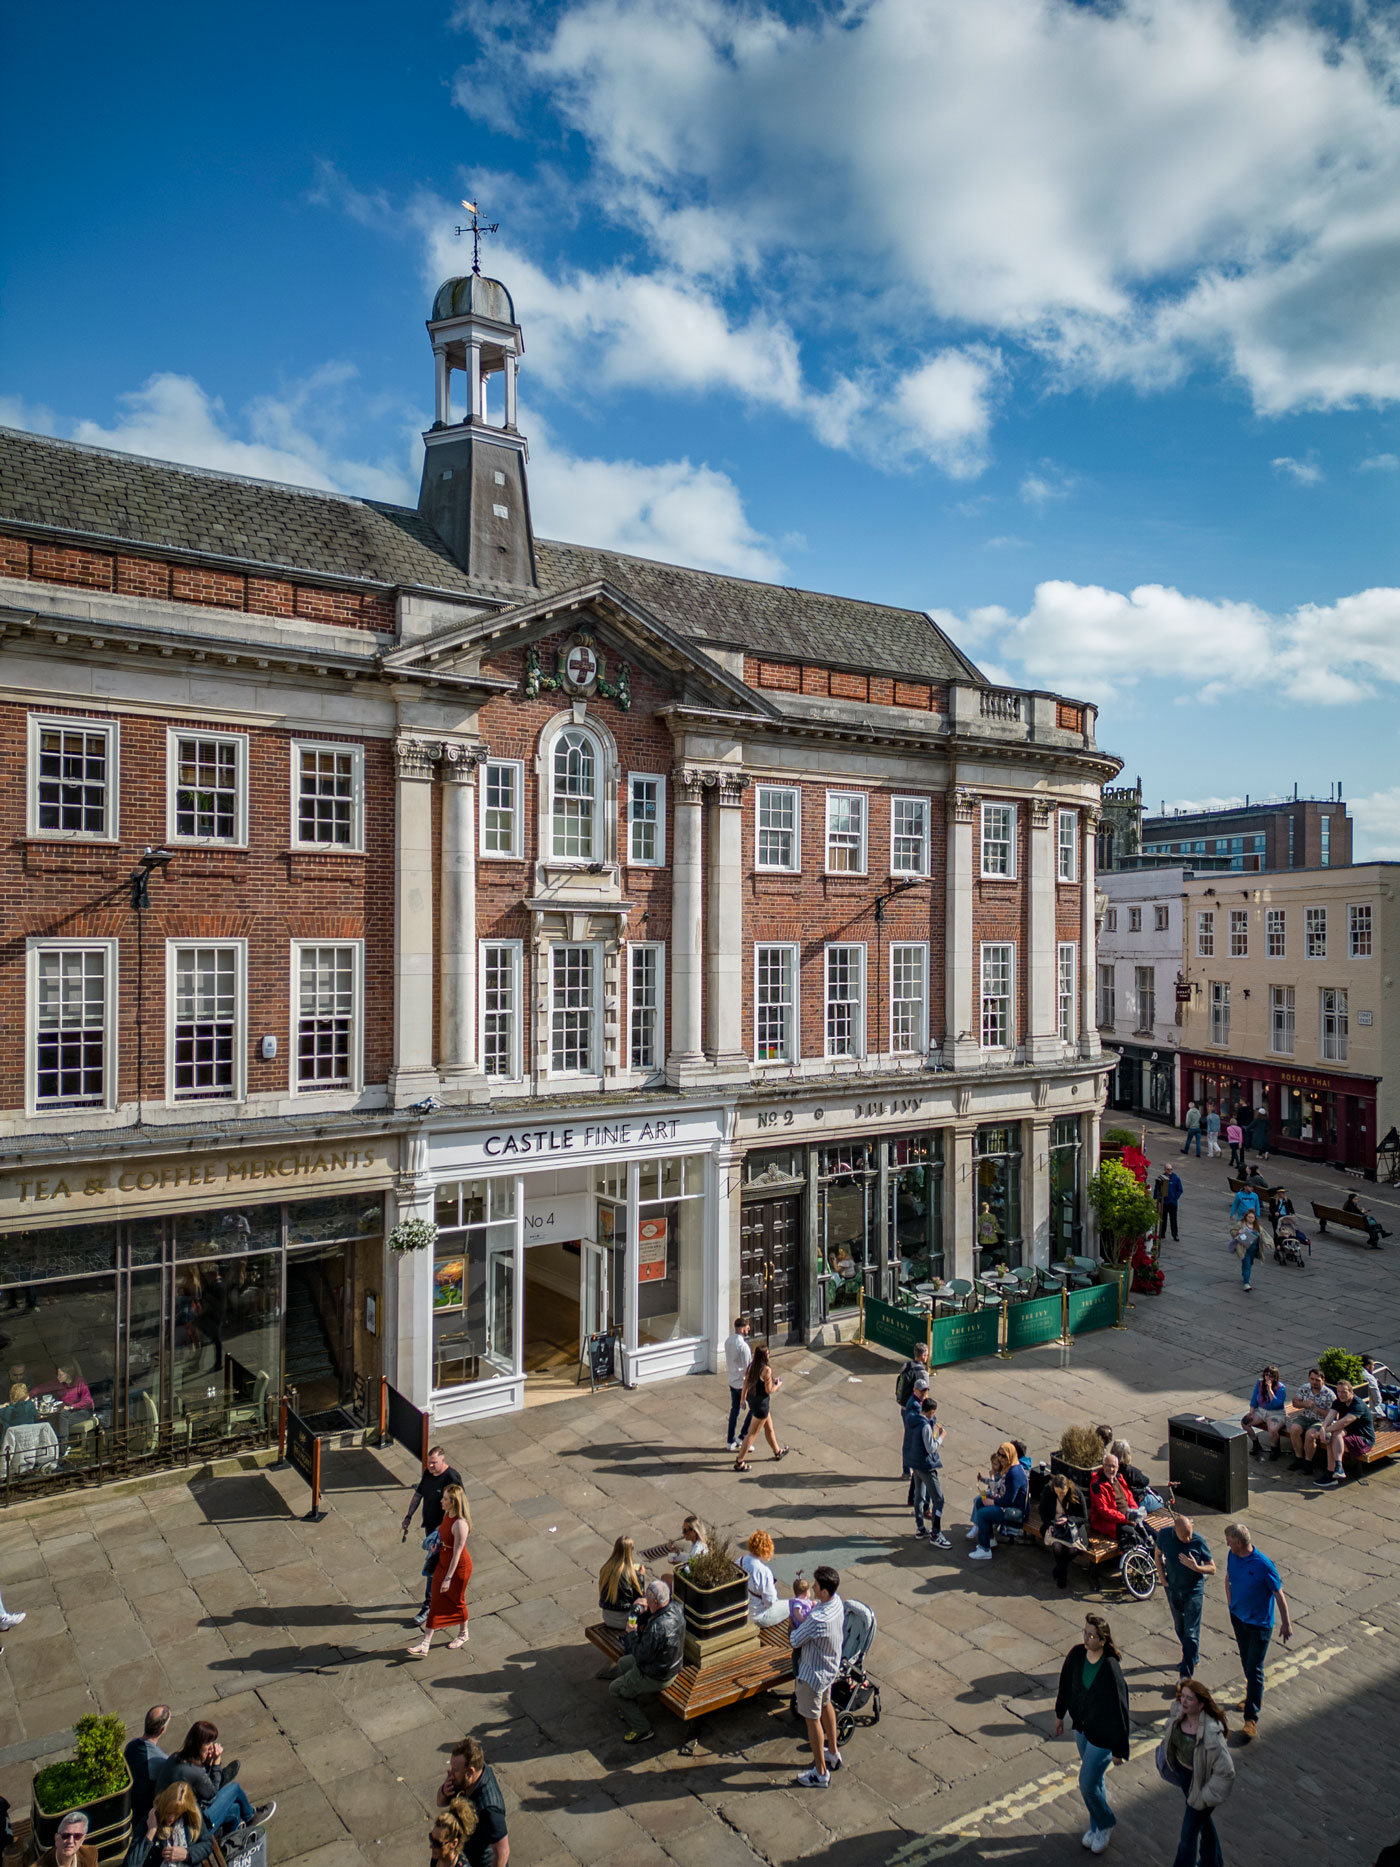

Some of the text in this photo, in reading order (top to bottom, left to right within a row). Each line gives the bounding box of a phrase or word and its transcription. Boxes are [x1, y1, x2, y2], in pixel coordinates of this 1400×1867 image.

[1151, 1052, 1158, 1060] JD
[1194, 1059, 1234, 1071] ROSA'S THAI
[1281, 1073, 1330, 1088] ROSA'S THAI
[890, 1098, 923, 1115] IVY
[783, 1109, 795, 1126] 2
[484, 1119, 681, 1156] CASTLE FINE ART
[16, 1148, 376, 1203] TEA & COFFEE MERCHANTS
[524, 1212, 555, 1229] No 4
[881, 1314, 910, 1332] THE IVY
[1021, 1309, 1048, 1321] THE IVY
[951, 1323, 981, 1336] THE IVY
[234, 1842, 263, 1862] ENJOY
